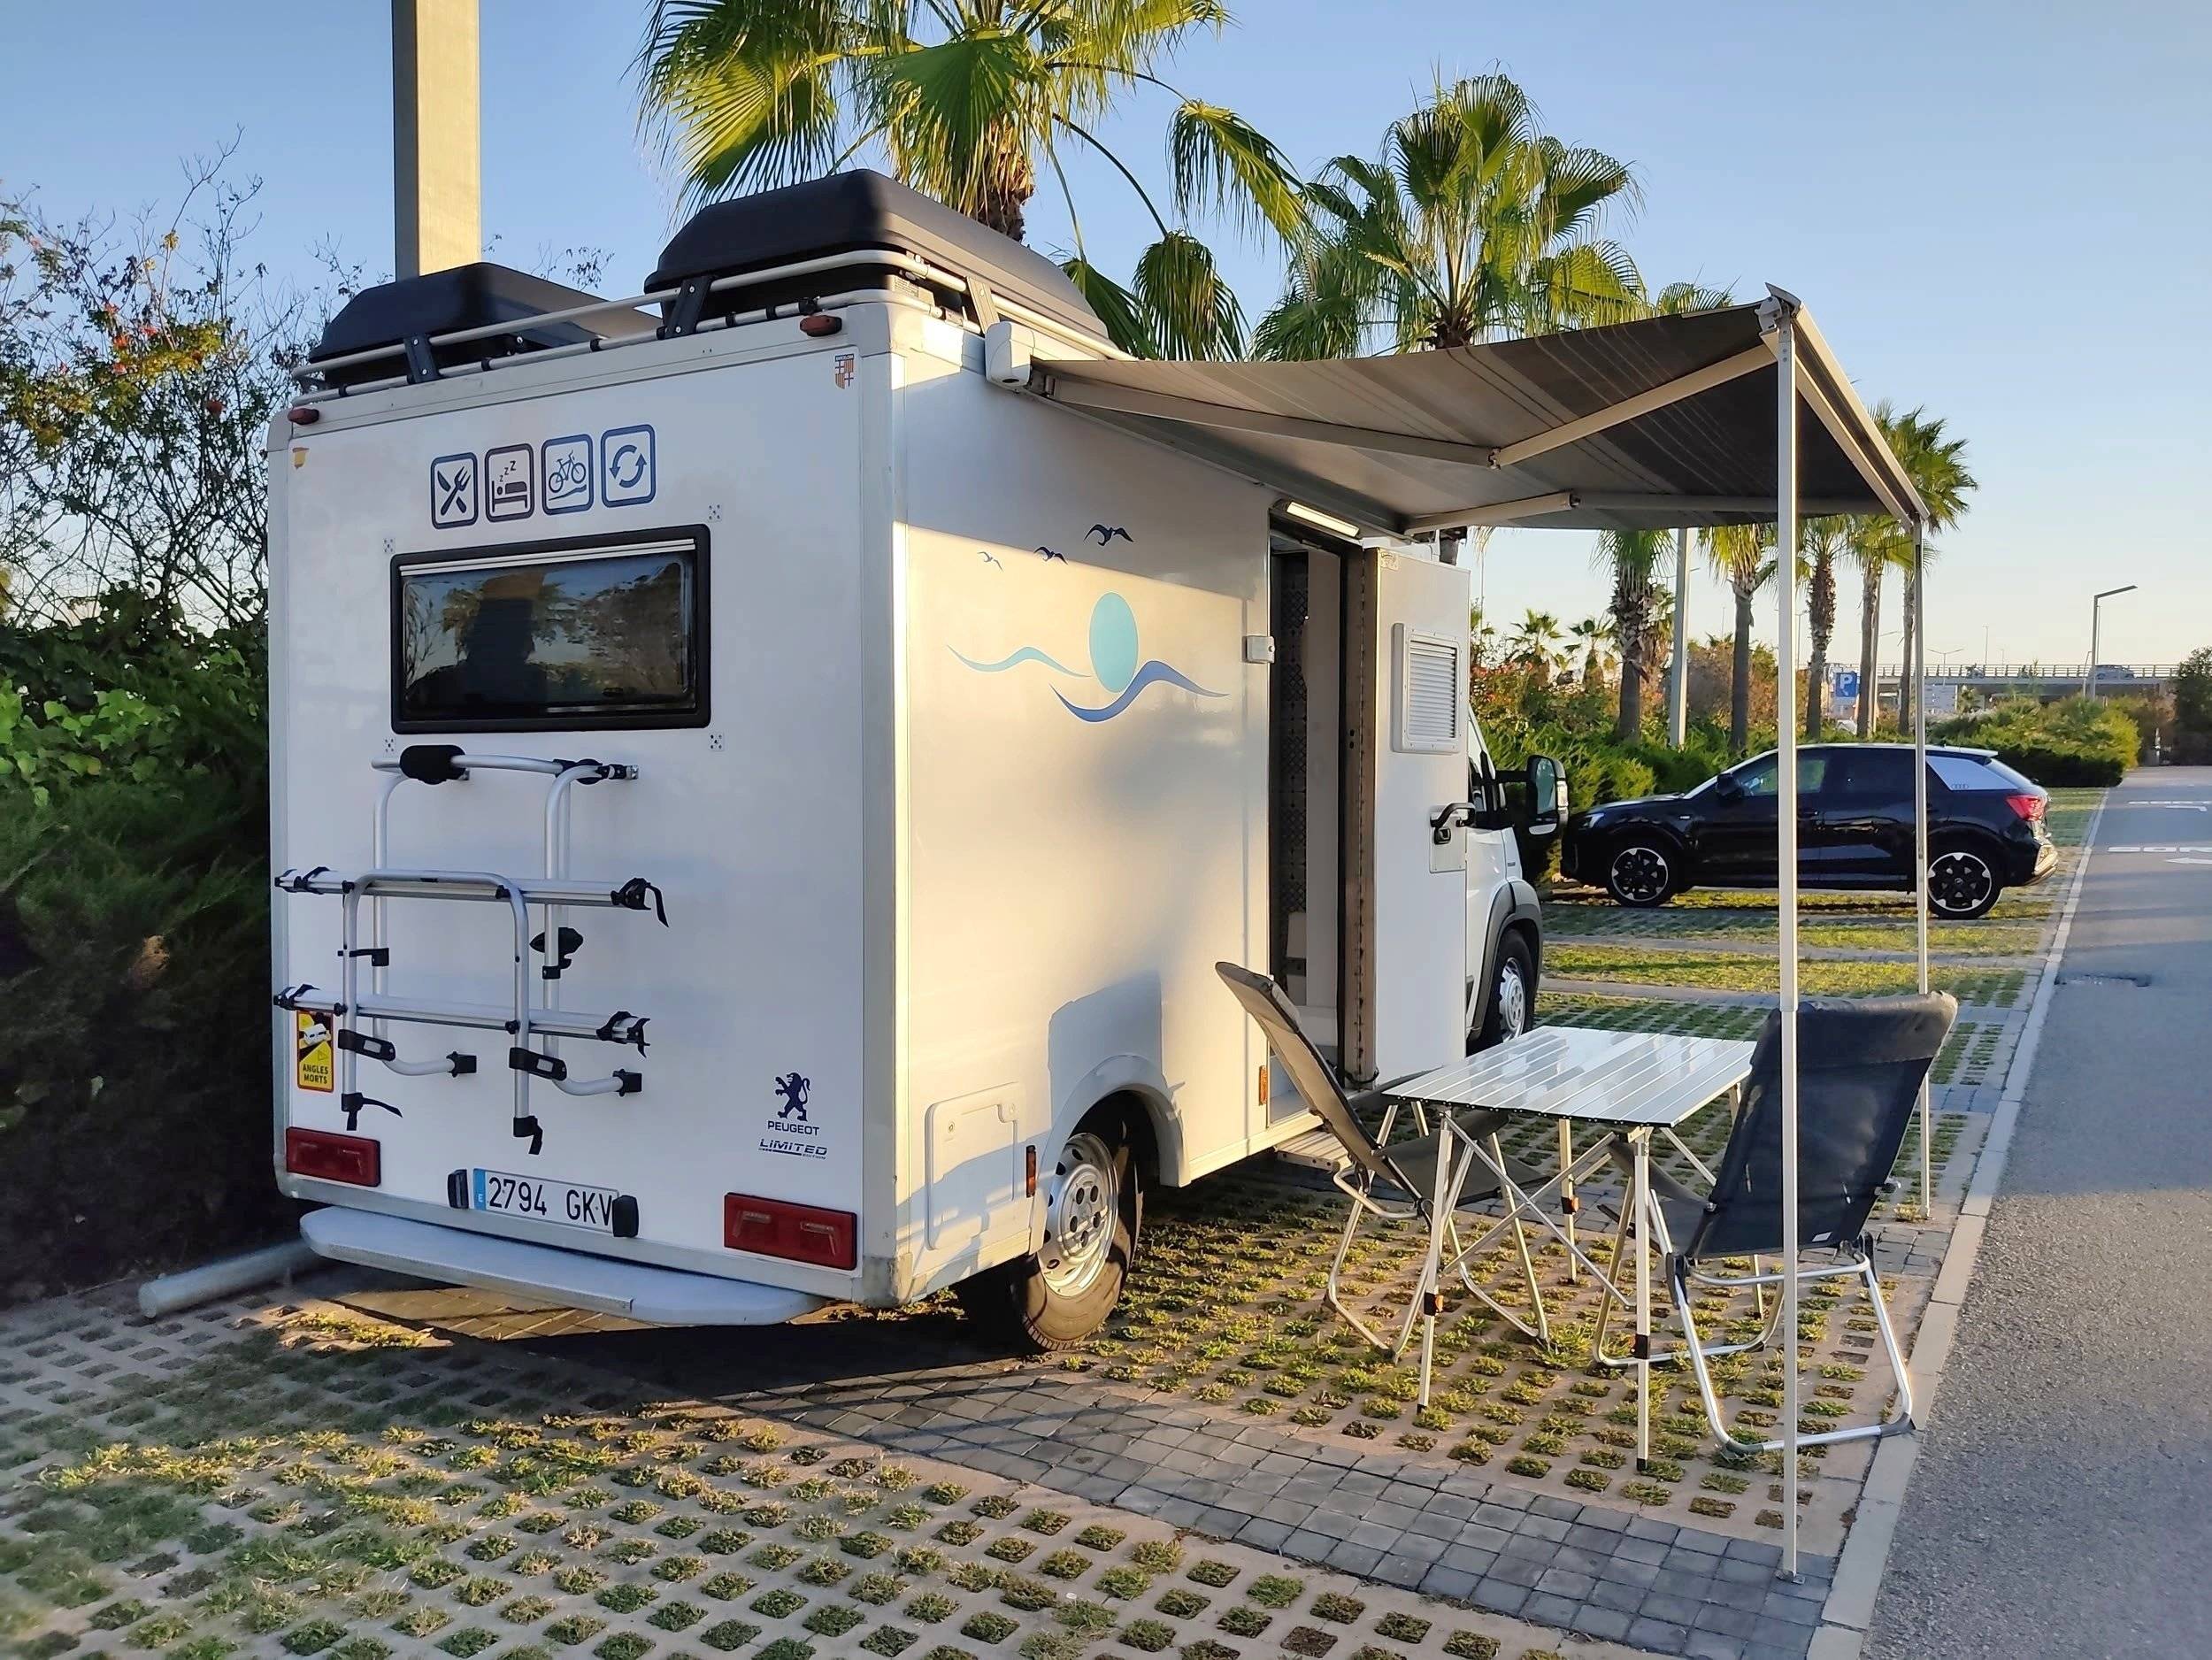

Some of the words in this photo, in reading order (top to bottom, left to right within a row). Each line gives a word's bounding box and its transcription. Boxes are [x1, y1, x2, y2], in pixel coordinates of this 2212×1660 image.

[1839, 673, 1854, 689] P
[303, 1064, 329, 1074] ANGLES
[303, 1073, 328, 1085] MORTS
[767, 1120, 820, 1136] PEUGEOT
[478, 1193, 483, 1203] E
[488, 1177, 547, 1216] 2794
[566, 1189, 613, 1226] GKV
